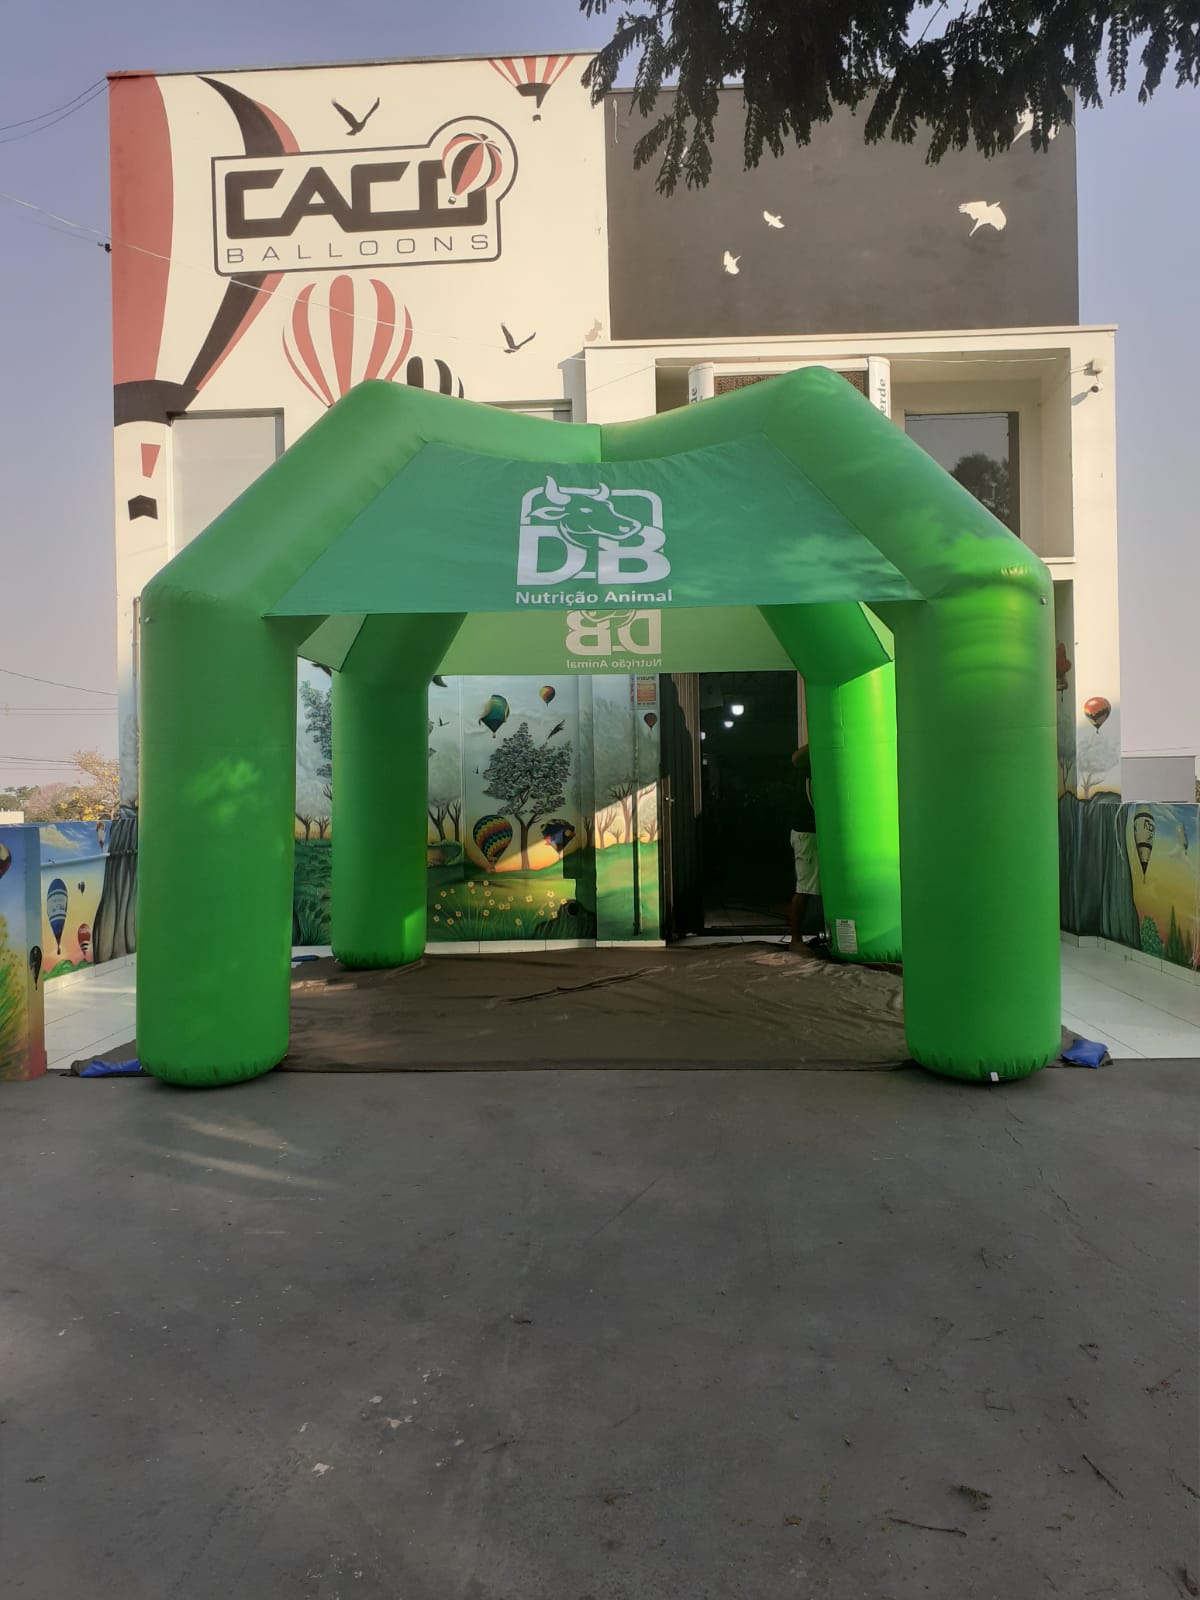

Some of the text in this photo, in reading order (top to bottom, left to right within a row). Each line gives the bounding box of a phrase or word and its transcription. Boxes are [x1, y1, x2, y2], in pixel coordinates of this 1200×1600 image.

[224, 159, 488, 239] CACO
[226, 234, 489, 264] BALLOONS
[516, 525, 671, 585] DB
[516, 589, 673, 606] Nutrição Animal
